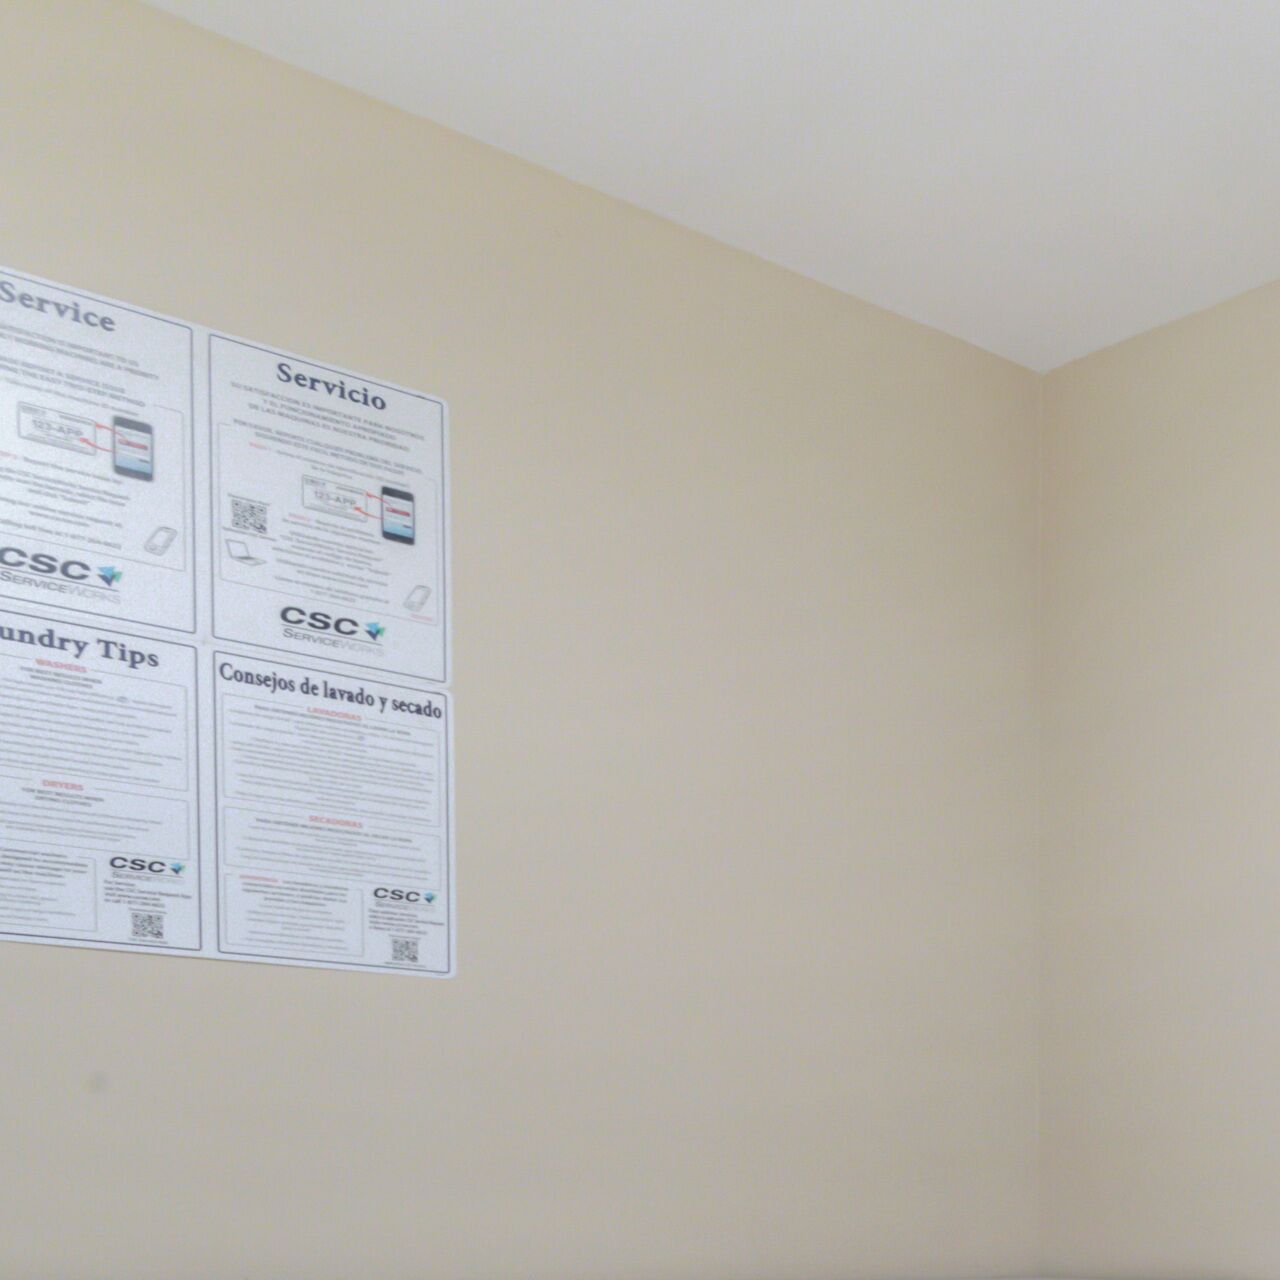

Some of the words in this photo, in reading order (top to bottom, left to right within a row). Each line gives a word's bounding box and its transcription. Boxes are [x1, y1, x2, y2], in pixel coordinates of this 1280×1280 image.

[0, 280, 116, 332] Service
[277, 362, 387, 411] Servicio
[0, 547, 91, 580] CSC
[280, 606, 360, 636] CSC
[97, 638, 160, 669] Tips
[219, 662, 296, 693] Consejos
[300, 677, 319, 697] de
[323, 680, 375, 707] lavado
[378, 696, 388, 713] y
[392, 698, 442, 719] secado
[110, 857, 167, 873] CSC
[373, 887, 421, 903] CSC
